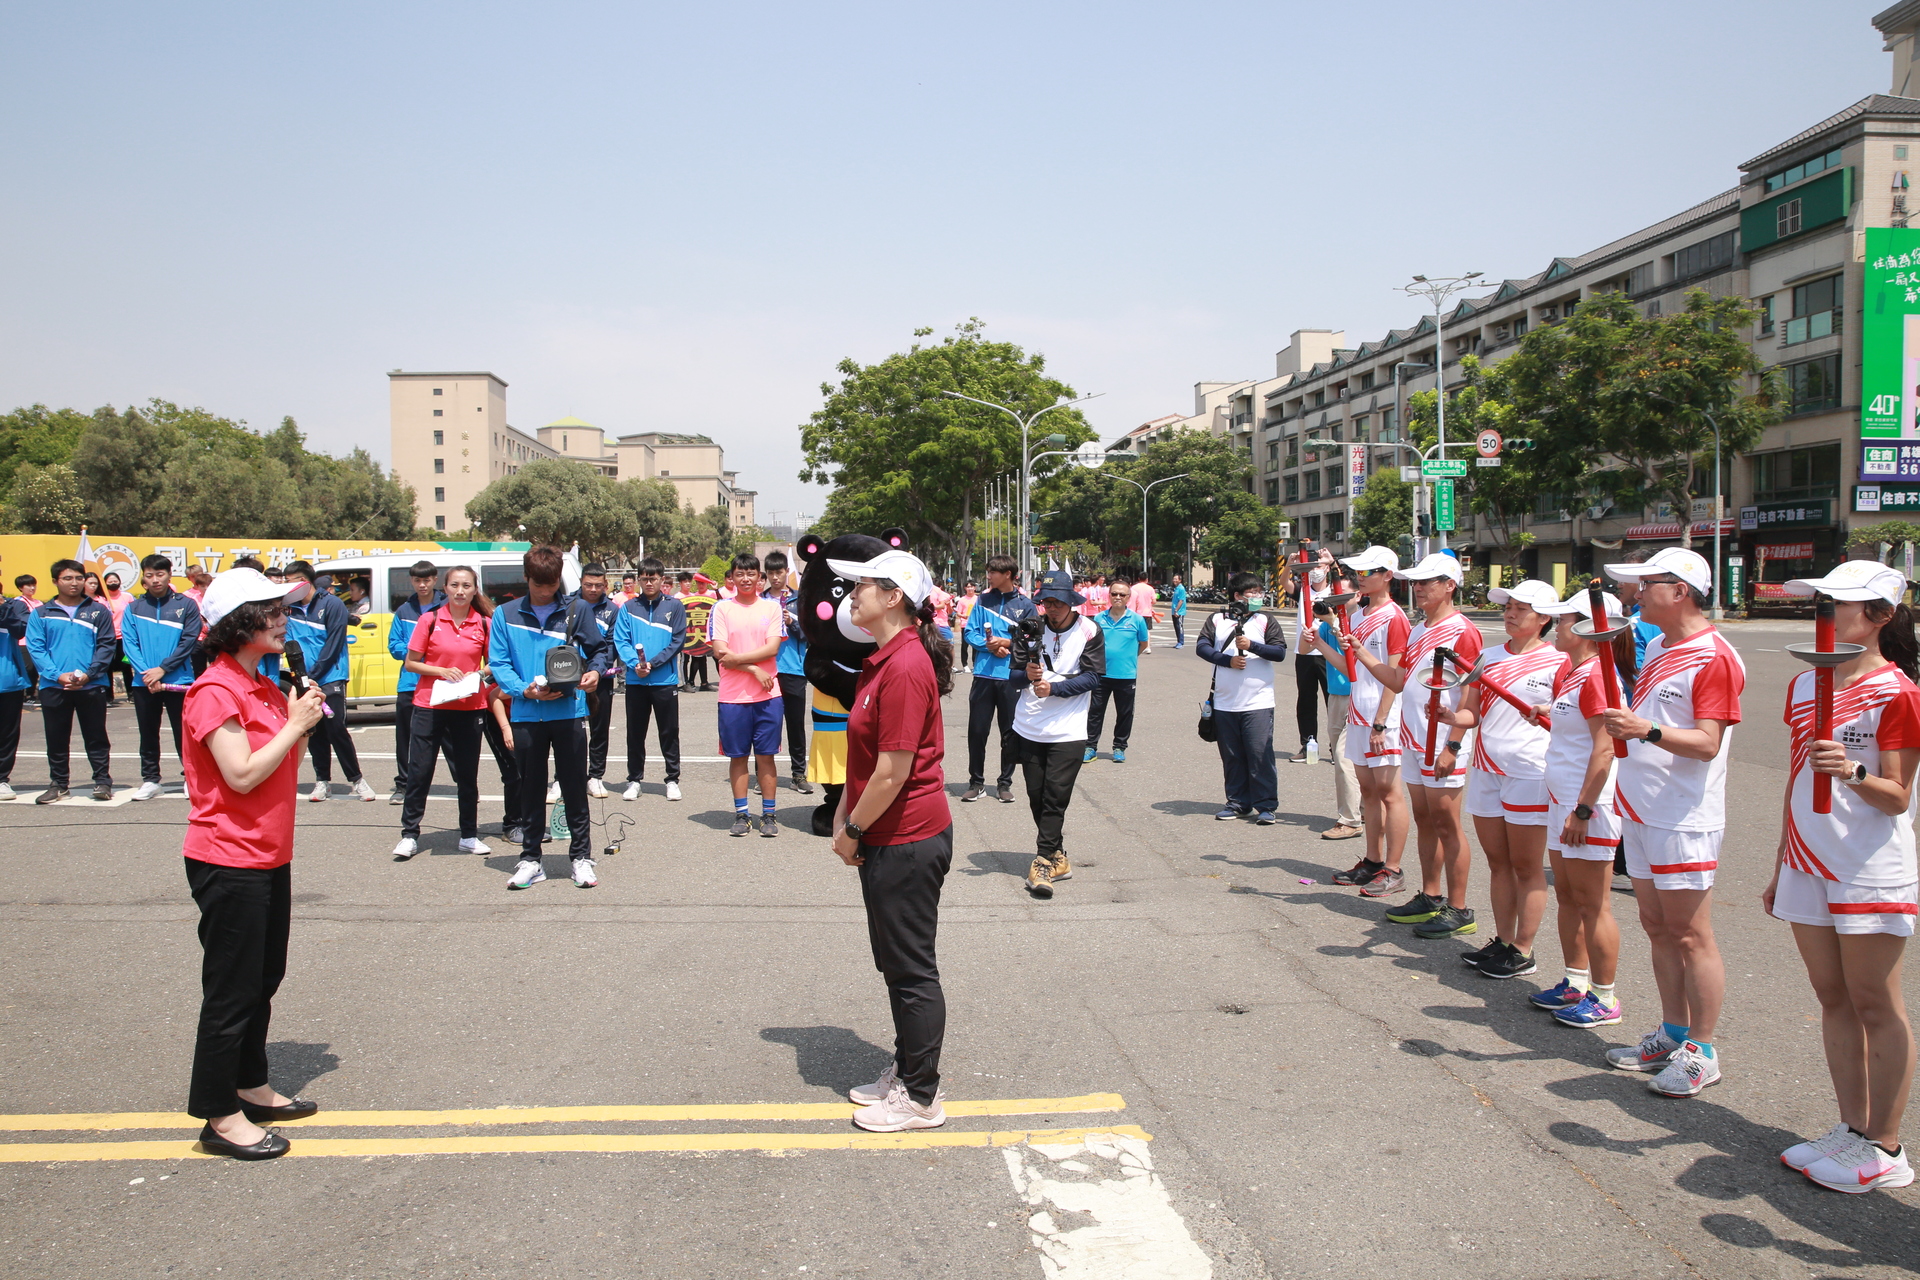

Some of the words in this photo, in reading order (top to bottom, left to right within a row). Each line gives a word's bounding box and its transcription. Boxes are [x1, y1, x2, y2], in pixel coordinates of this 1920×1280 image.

[1904, 286, 1920, 304] 希
[1482, 438, 1497, 449] 50
[1869, 449, 1893, 461] 住商
[1352, 446, 1365, 498] 光祥影印
[1900, 464, 1920, 475] 36
[1861, 491, 1876, 499] 住商
[1882, 492, 1920, 505] 住商不
[1758, 508, 1806, 523] 住商不動產
[684, 607, 713, 648] 高大
[553, 661, 572, 669] Hylex
